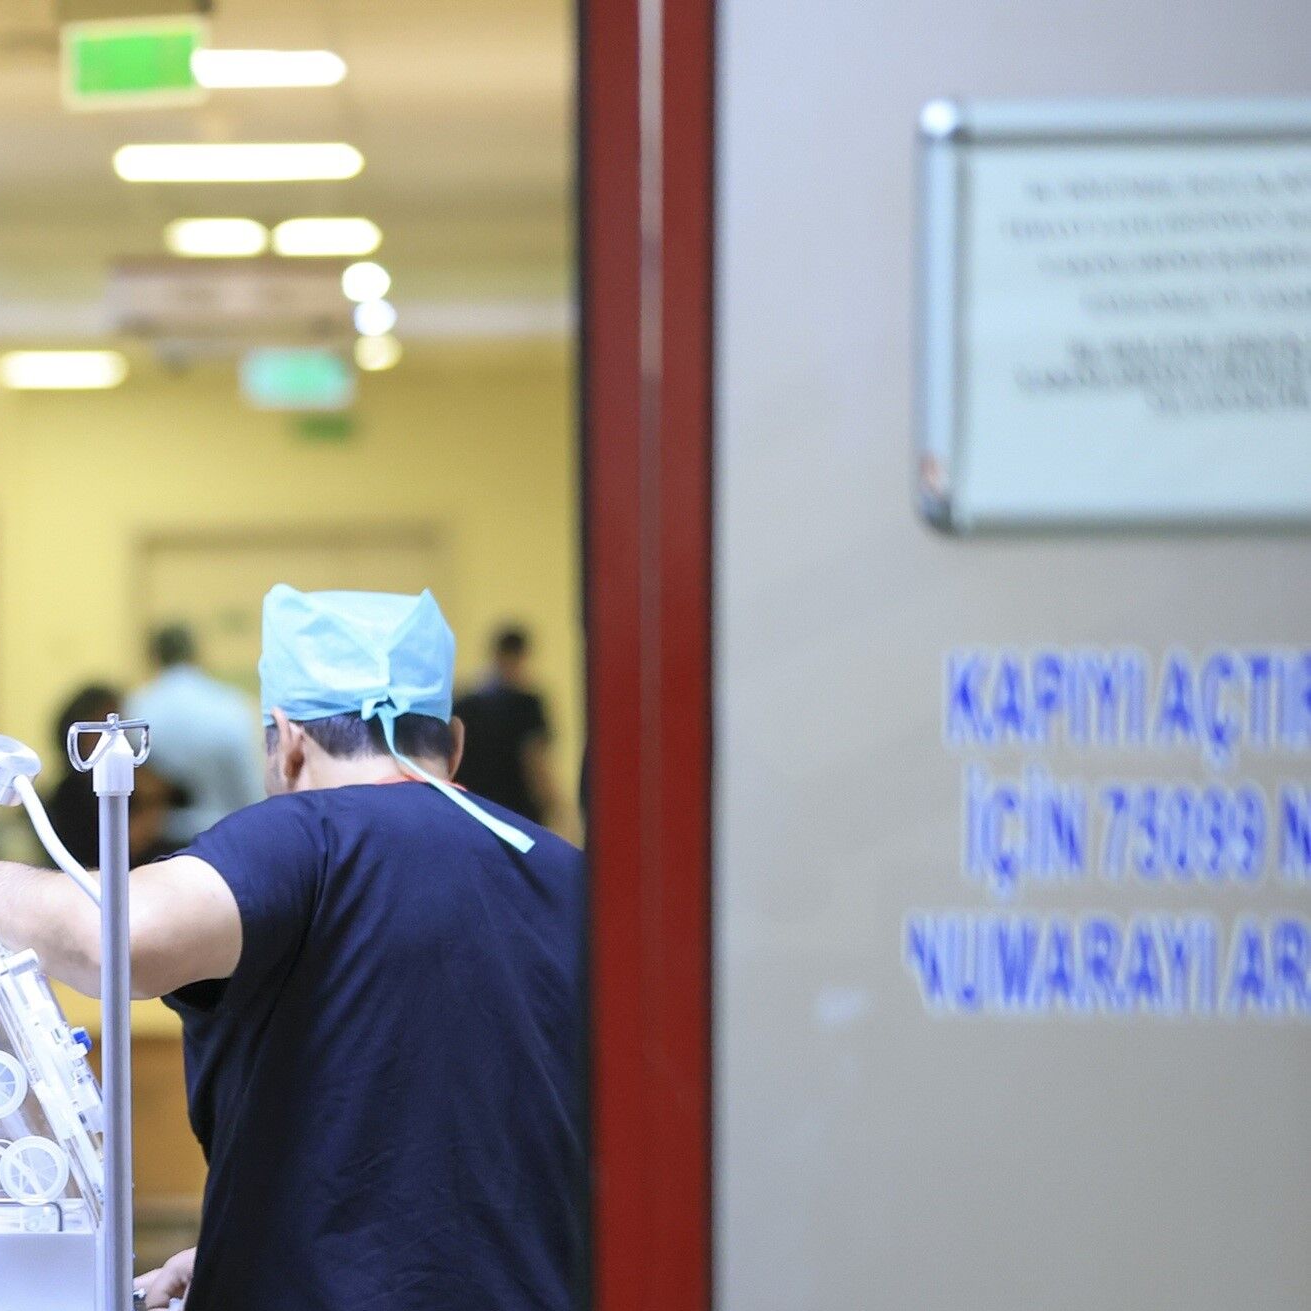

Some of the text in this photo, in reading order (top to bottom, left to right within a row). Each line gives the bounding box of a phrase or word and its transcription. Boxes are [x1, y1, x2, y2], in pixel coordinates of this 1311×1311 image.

[947, 650, 1149, 747] KAPIYI
[961, 762, 1084, 896] İÇİN
[904, 912, 1216, 1012] NUMARAYI
